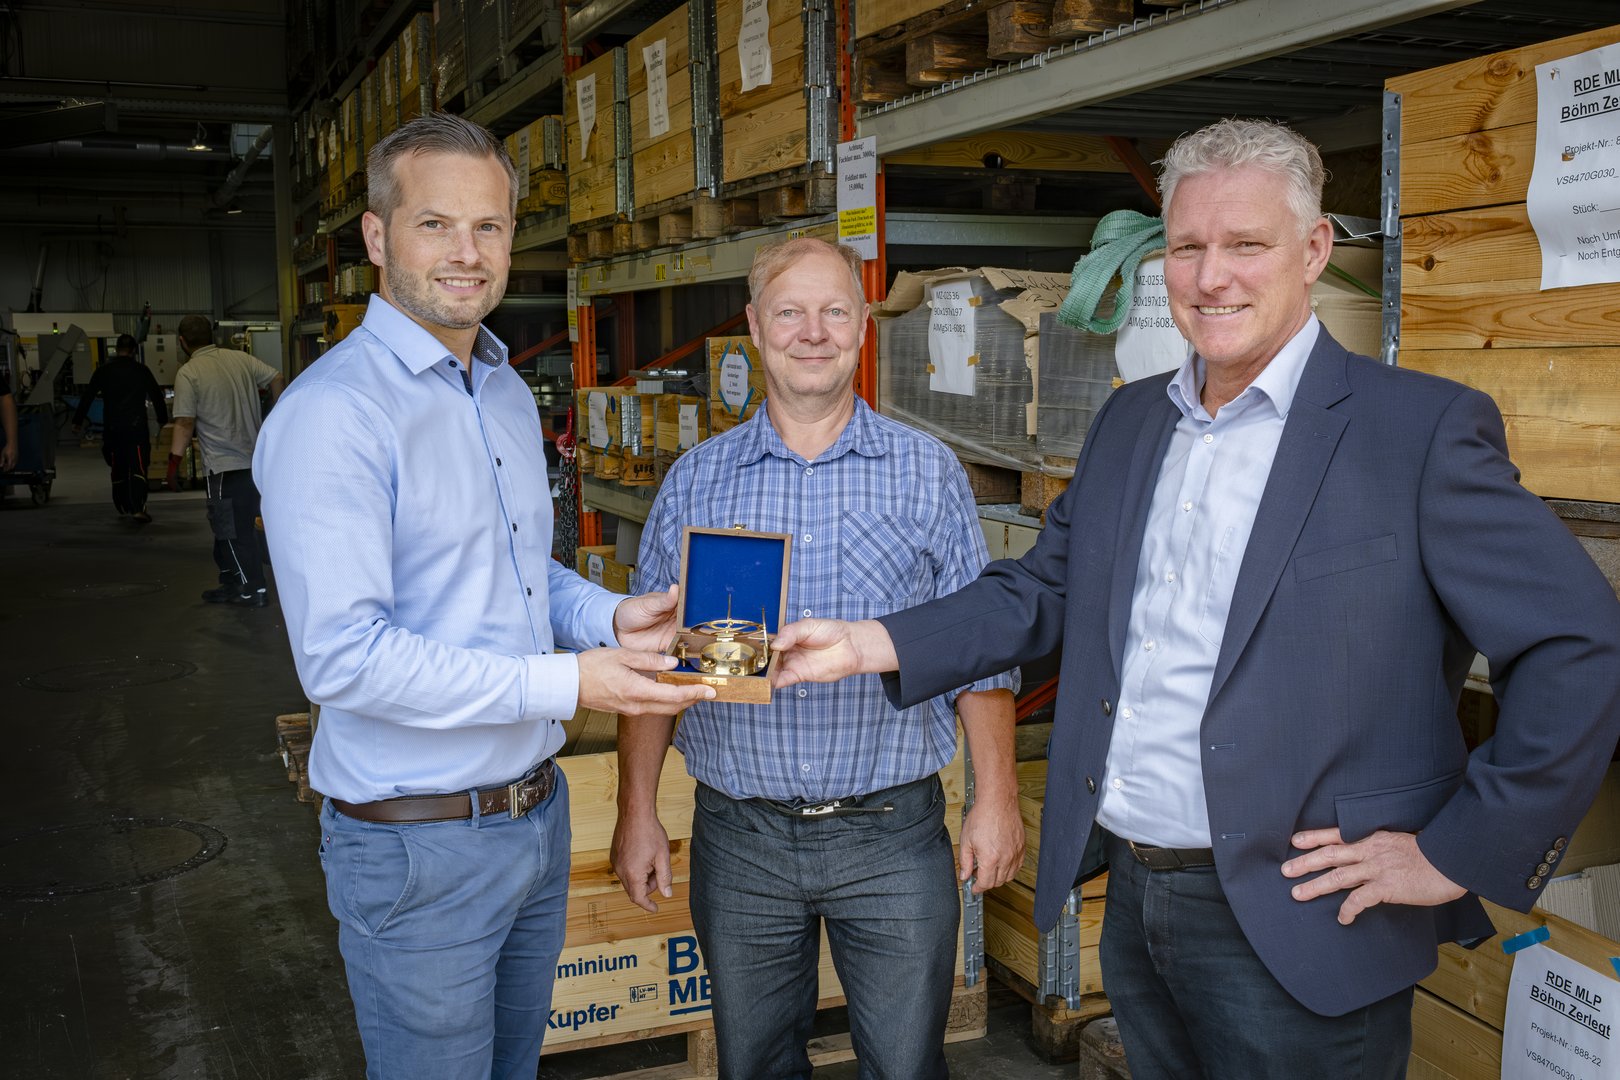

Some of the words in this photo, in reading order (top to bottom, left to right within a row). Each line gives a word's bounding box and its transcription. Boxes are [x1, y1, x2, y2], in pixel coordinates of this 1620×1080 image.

[1574, 74, 1600, 94] RDE
[1561, 102, 1599, 120] Böhm
[1603, 96, 1620, 110] Ze
[848, 142, 865, 152] Achtung!
[1564, 138, 1613, 156] Projekt-Nr.:
[1577, 234, 1601, 245] Noch
[1577, 249, 1600, 261] Noch
[1136, 275, 1167, 286] MZ-0253
[936, 291, 960, 301] MZ-02536
[934, 307, 963, 317] 90x197x197
[933, 323, 966, 334] AlMgSi1-6082
[1127, 317, 1175, 330] AlMgSi1-6082
[668, 935, 708, 976] B
[1545, 970, 1572, 993] RDE
[1575, 985, 1602, 1006] MLP
[547, 1004, 621, 1031] Kupfer
[1531, 984, 1565, 1012] Böhm
[1568, 1004, 1611, 1037] Zerlegt
[1531, 1022, 1572, 1051] Projekt-Nr.:
[1574, 1045, 1602, 1067] 888-22
